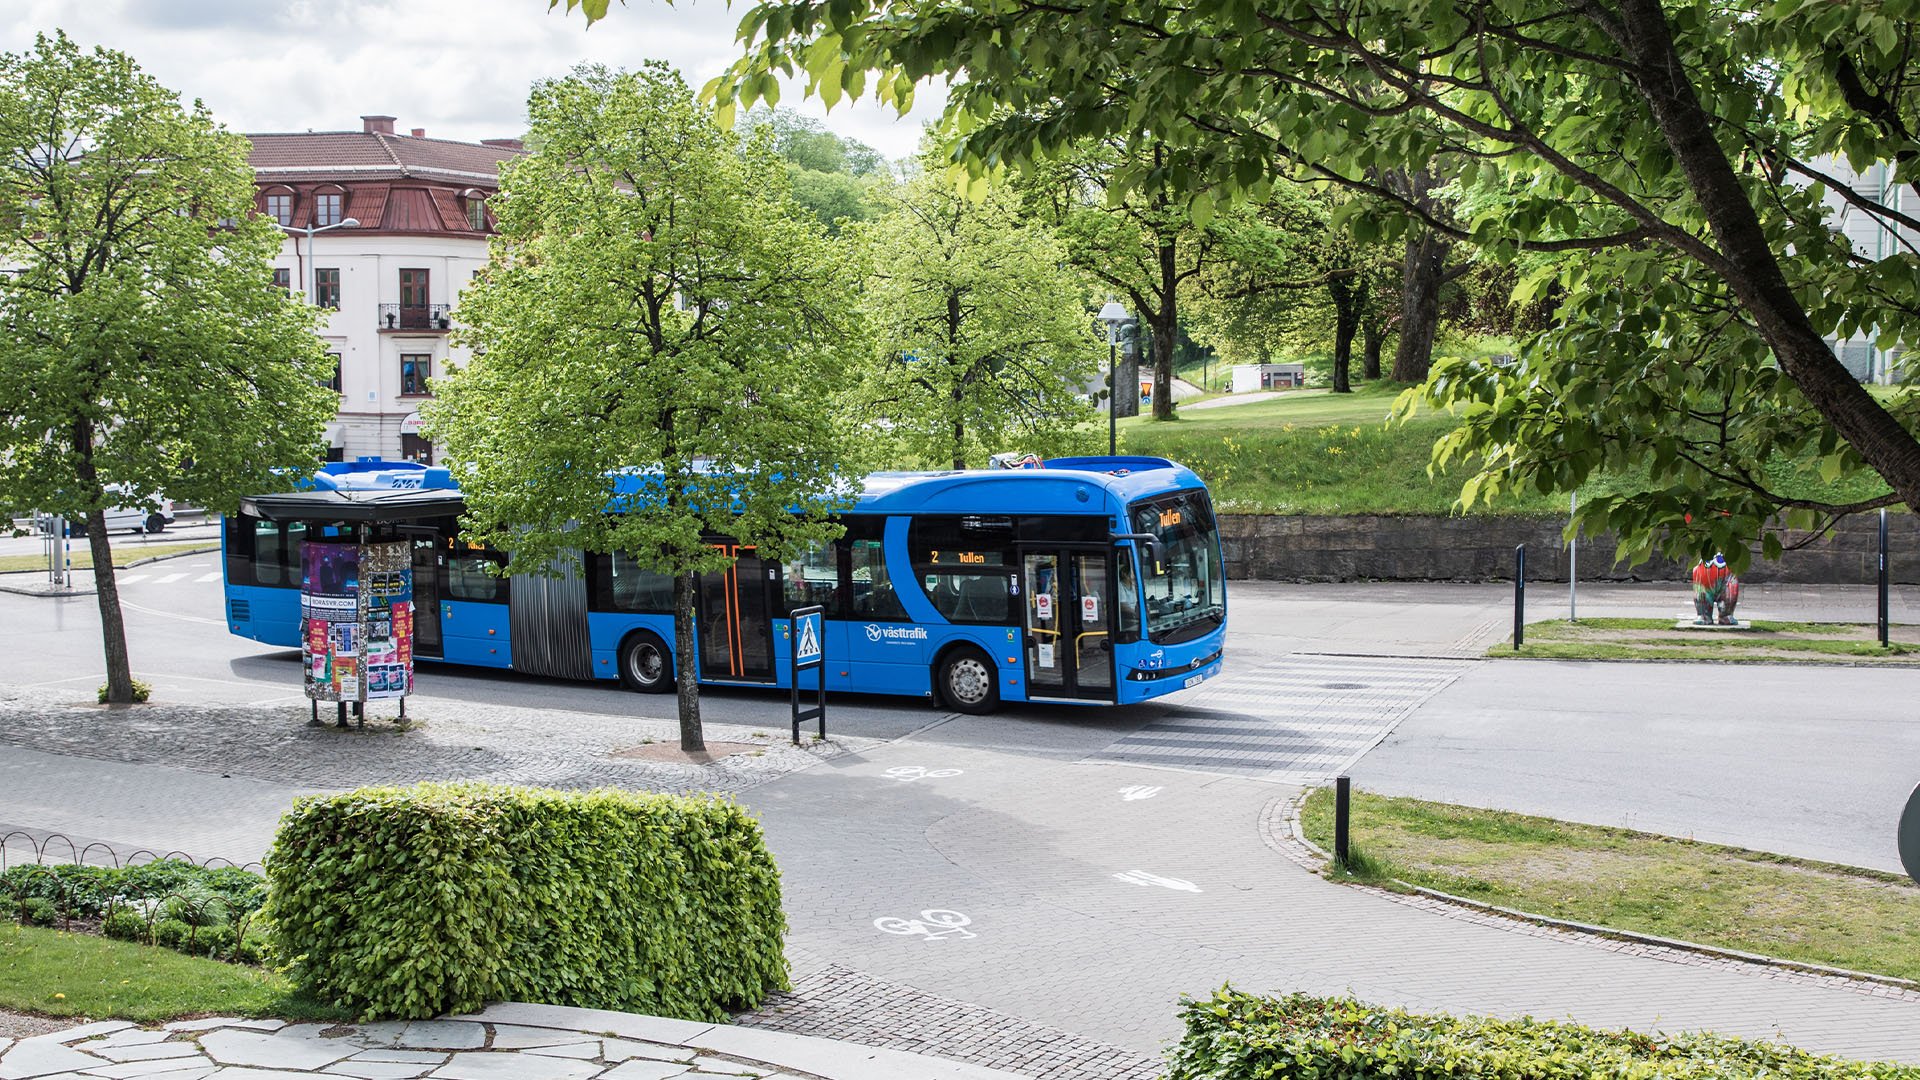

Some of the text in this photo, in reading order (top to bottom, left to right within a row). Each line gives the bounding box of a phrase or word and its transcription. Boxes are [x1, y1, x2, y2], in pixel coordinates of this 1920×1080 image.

[1158, 508, 1181, 527] Tullen
[448, 537, 454, 549] 2
[931, 550, 985, 563] 2 Tullen
[1155, 560, 1165, 575] L
[882, 626, 928, 639] västtrafik
